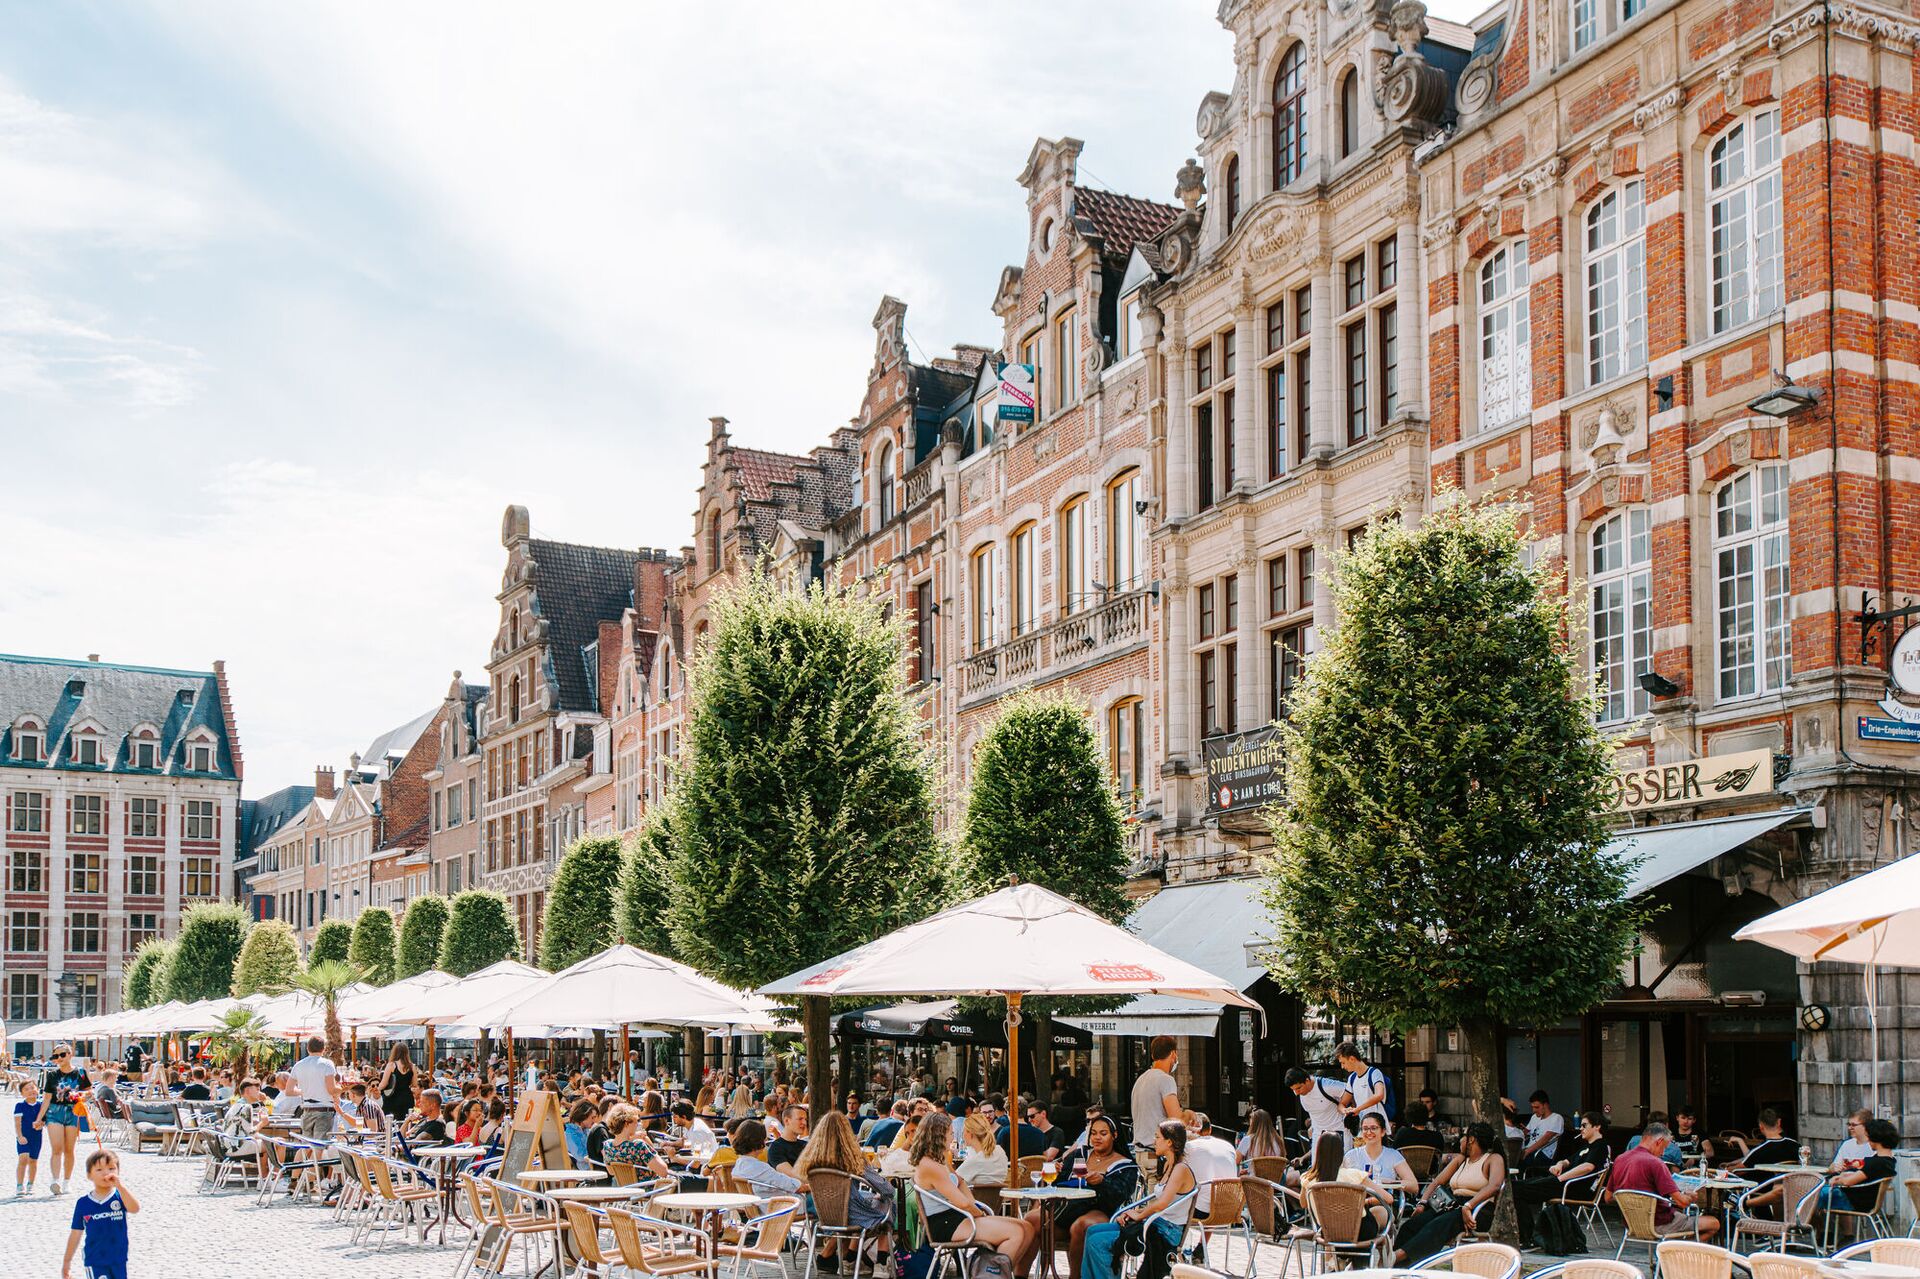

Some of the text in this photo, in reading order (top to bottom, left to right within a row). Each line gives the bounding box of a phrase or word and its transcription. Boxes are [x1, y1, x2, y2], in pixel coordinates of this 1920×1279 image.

[1004, 382, 1034, 407] VERKOCHT
[1893, 706, 1912, 719] DEN
[1210, 746, 1278, 775] STUDENTNIGHT
[1220, 764, 1269, 783] ELKE DINSDAGAVOND
[1212, 792, 1217, 804] 5
[1241, 786, 1254, 800] AAN
[1262, 780, 1281, 795] EURO
[1602, 763, 1704, 810] OSSER
[1095, 966, 1143, 974] STELLA
[1081, 1022, 1117, 1031] DE WEERELT
